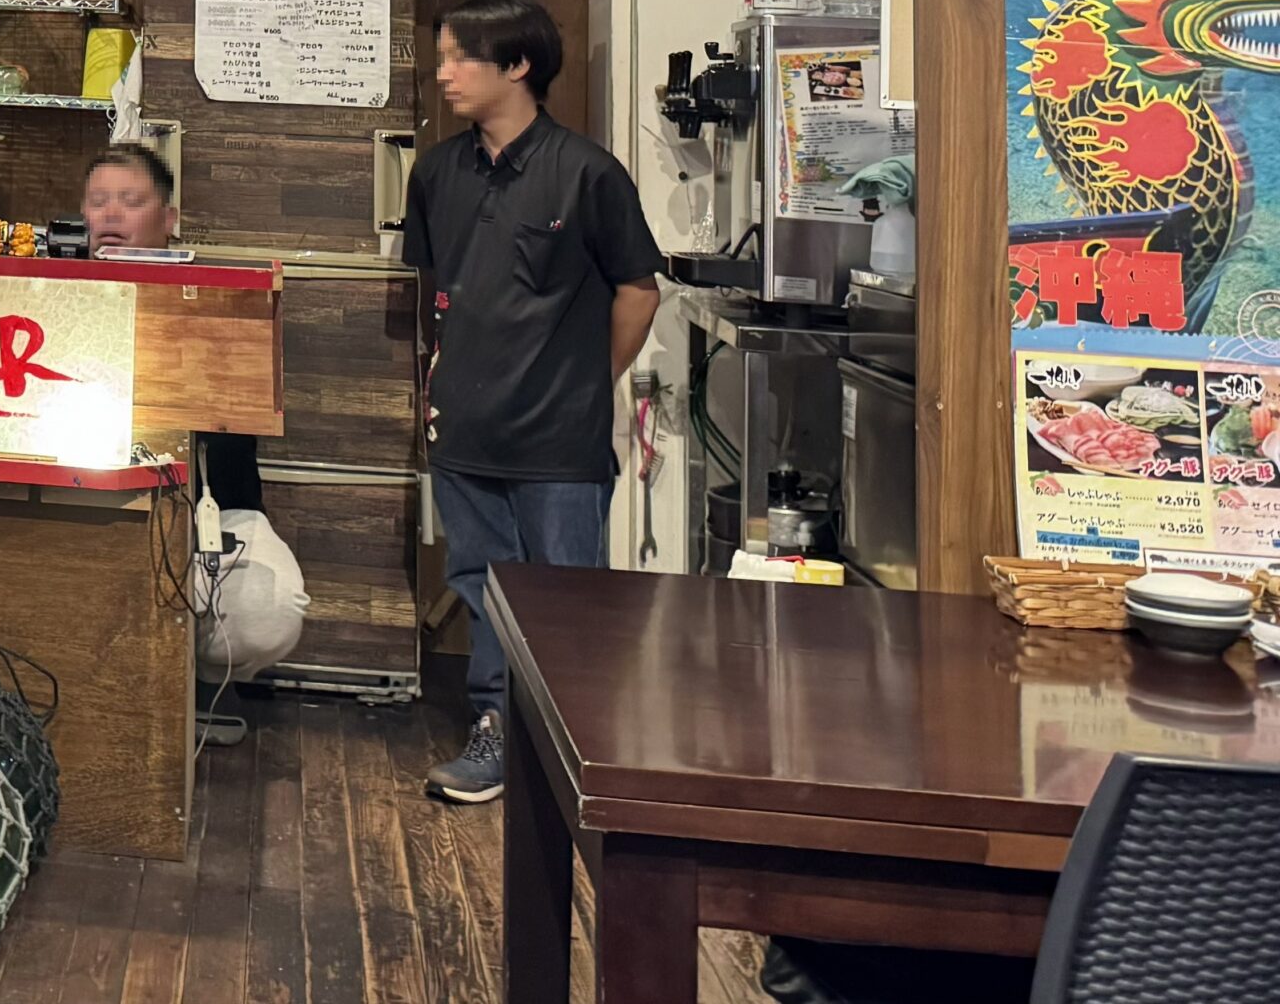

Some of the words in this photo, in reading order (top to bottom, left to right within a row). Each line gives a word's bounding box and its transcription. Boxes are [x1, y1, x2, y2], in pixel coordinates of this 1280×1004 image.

[1015, 244, 1186, 331] 沖縄
[1157, 495, 1201, 507] ¥2,970
[1160, 523, 1204, 535] ¥3,520
